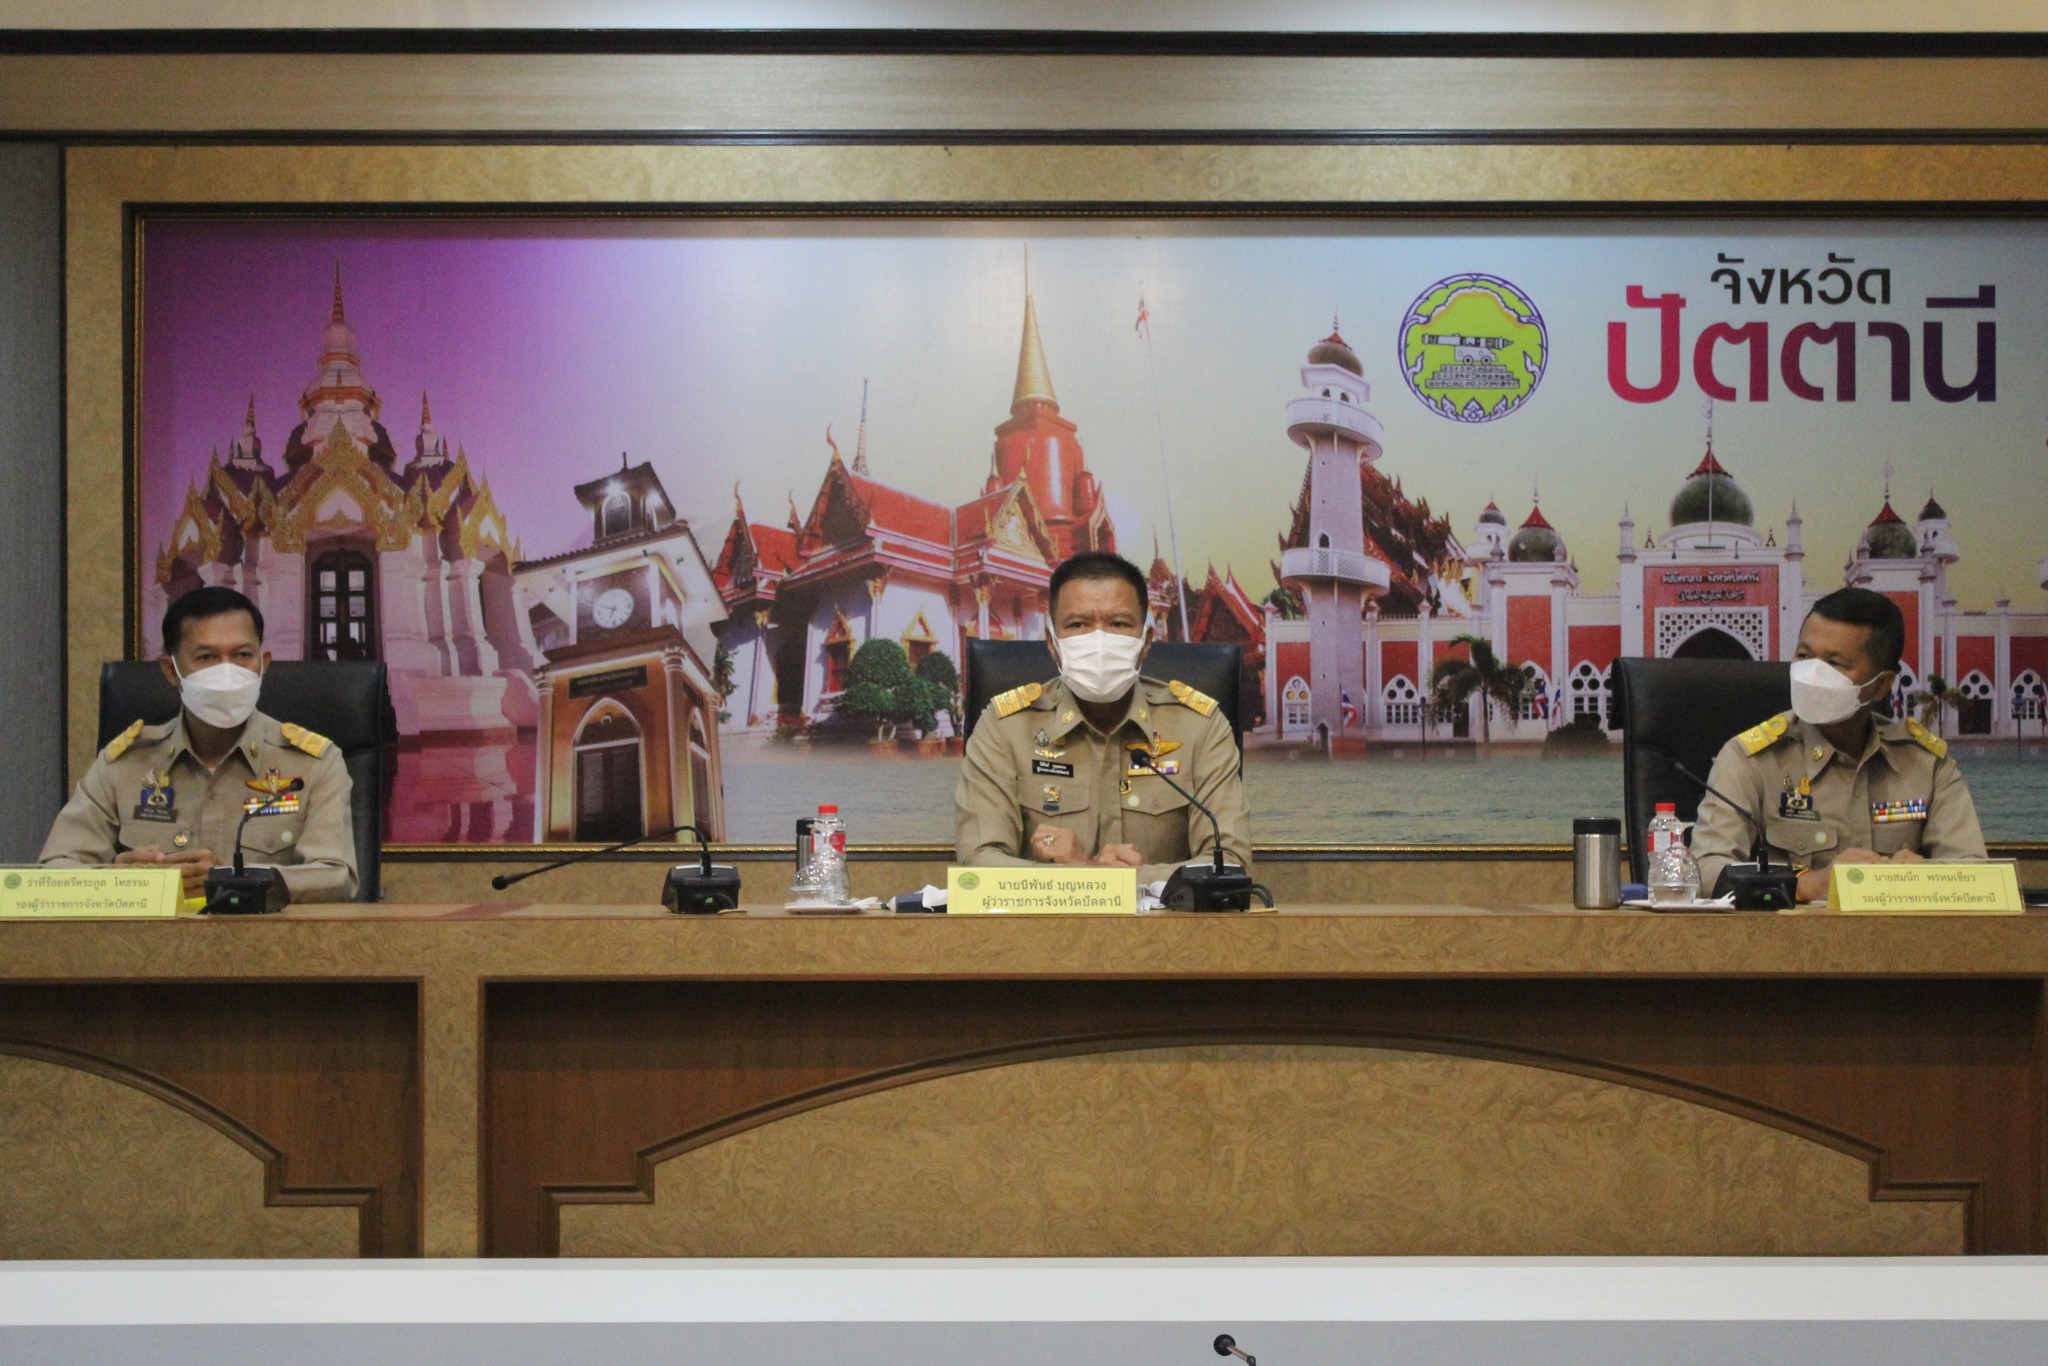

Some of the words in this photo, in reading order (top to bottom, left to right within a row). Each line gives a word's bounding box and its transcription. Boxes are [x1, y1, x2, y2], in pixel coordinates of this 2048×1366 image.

[1710, 252, 1891, 305] จังหวัด
[1607, 285, 1997, 404] ปัตตานี
[1874, 872, 1920, 882] นายสมนึก
[998, 878, 1054, 891] นายนิพันธ์
[1058, 880, 1107, 892] บุญหลวง
[16, 897, 148, 912] รองผู้ว่าราชการจังหวัดปัตตานี
[982, 895, 1122, 910] ผู้ว่าราชการจังหวัดปัตตานี
[1862, 892, 1995, 906] รองผู้ว่าราชการจังหวัดปัตตานี
